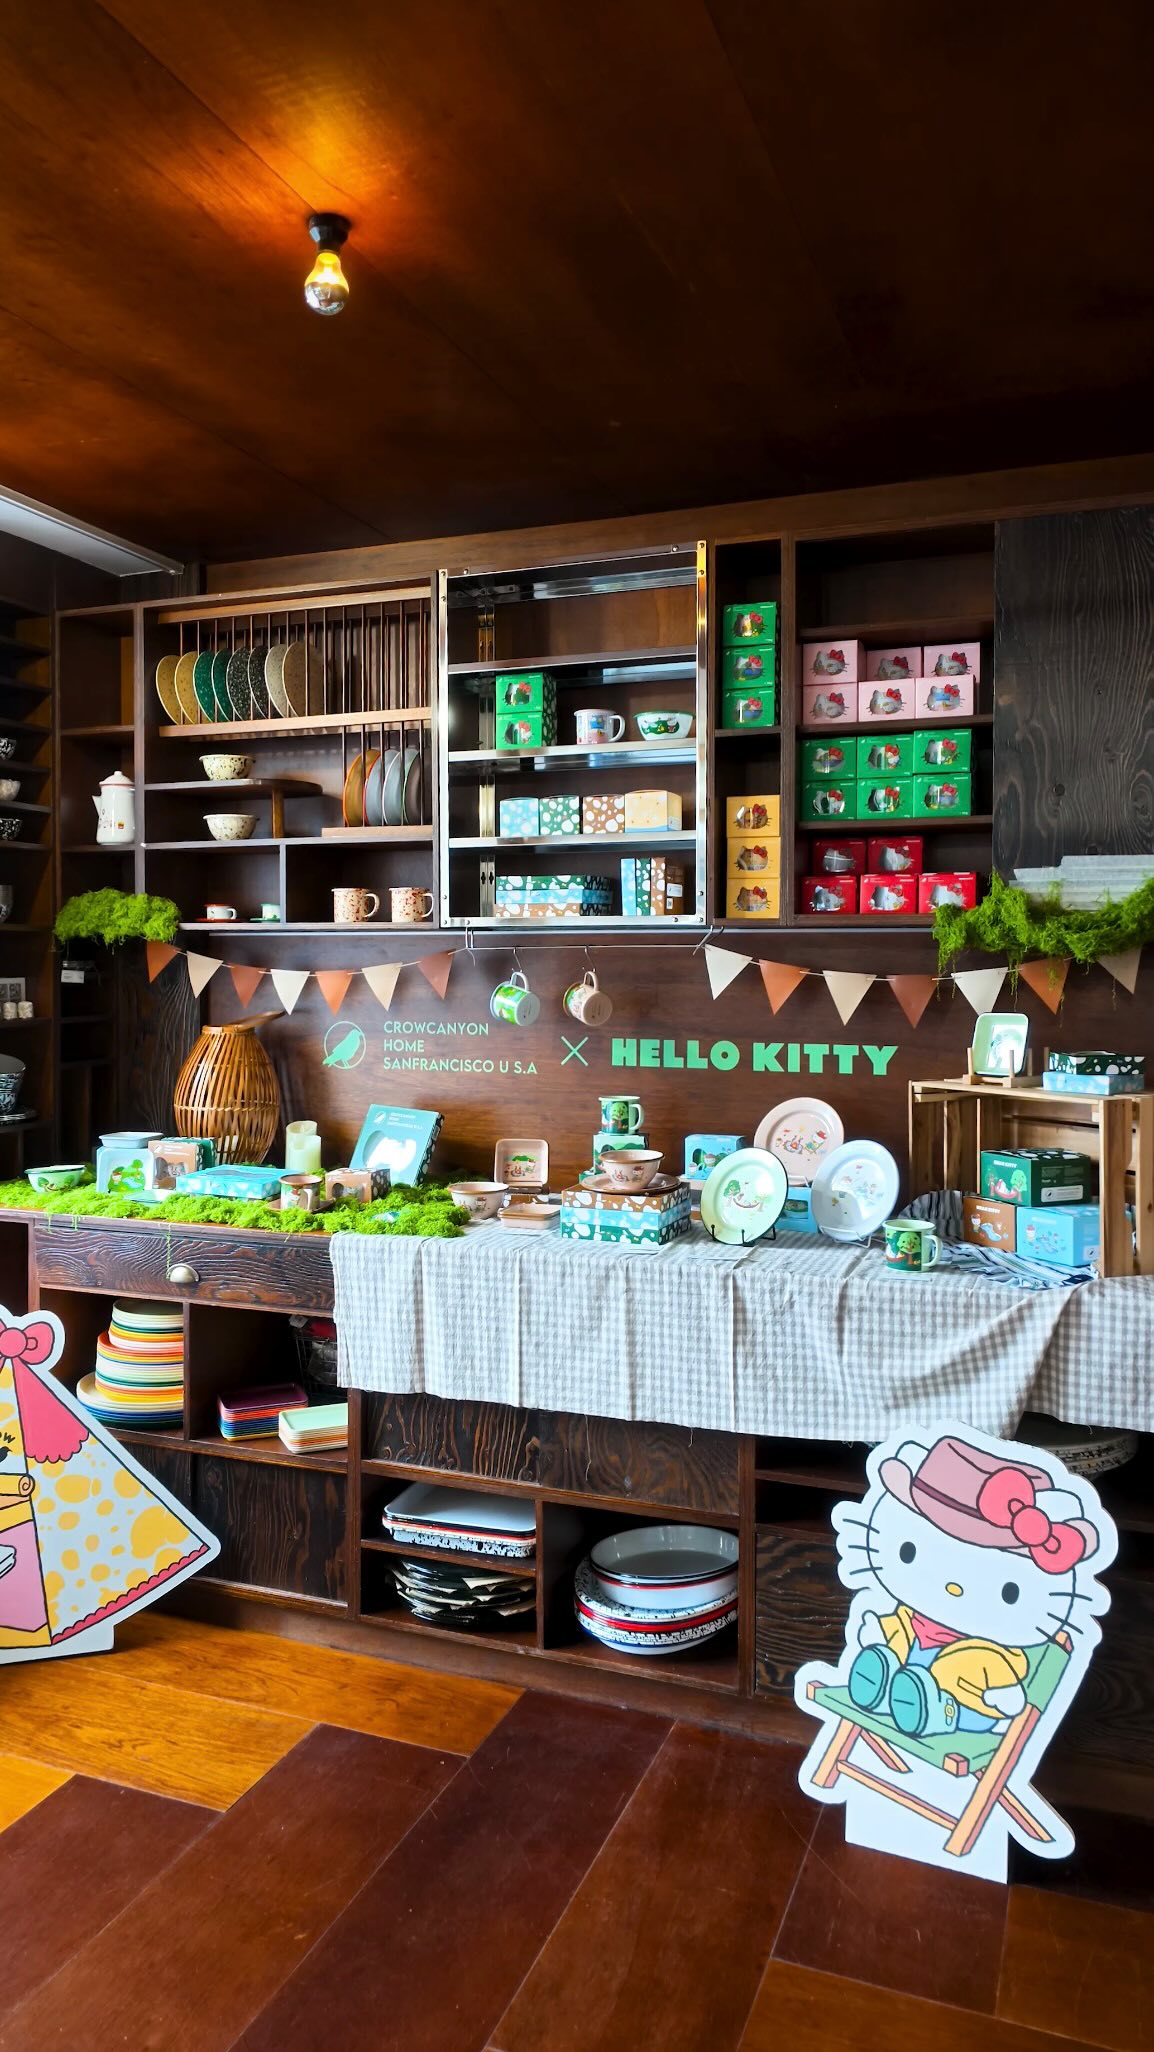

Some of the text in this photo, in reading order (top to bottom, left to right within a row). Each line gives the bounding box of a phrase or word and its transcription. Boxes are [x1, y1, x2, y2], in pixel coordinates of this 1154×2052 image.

[383, 1020, 489, 1036] CROWCANYON
[383, 1039, 425, 1053] HOME
[383, 1057, 495, 1073] SANFRANCISCO
[611, 1038, 899, 1076] HELLO KITTY
